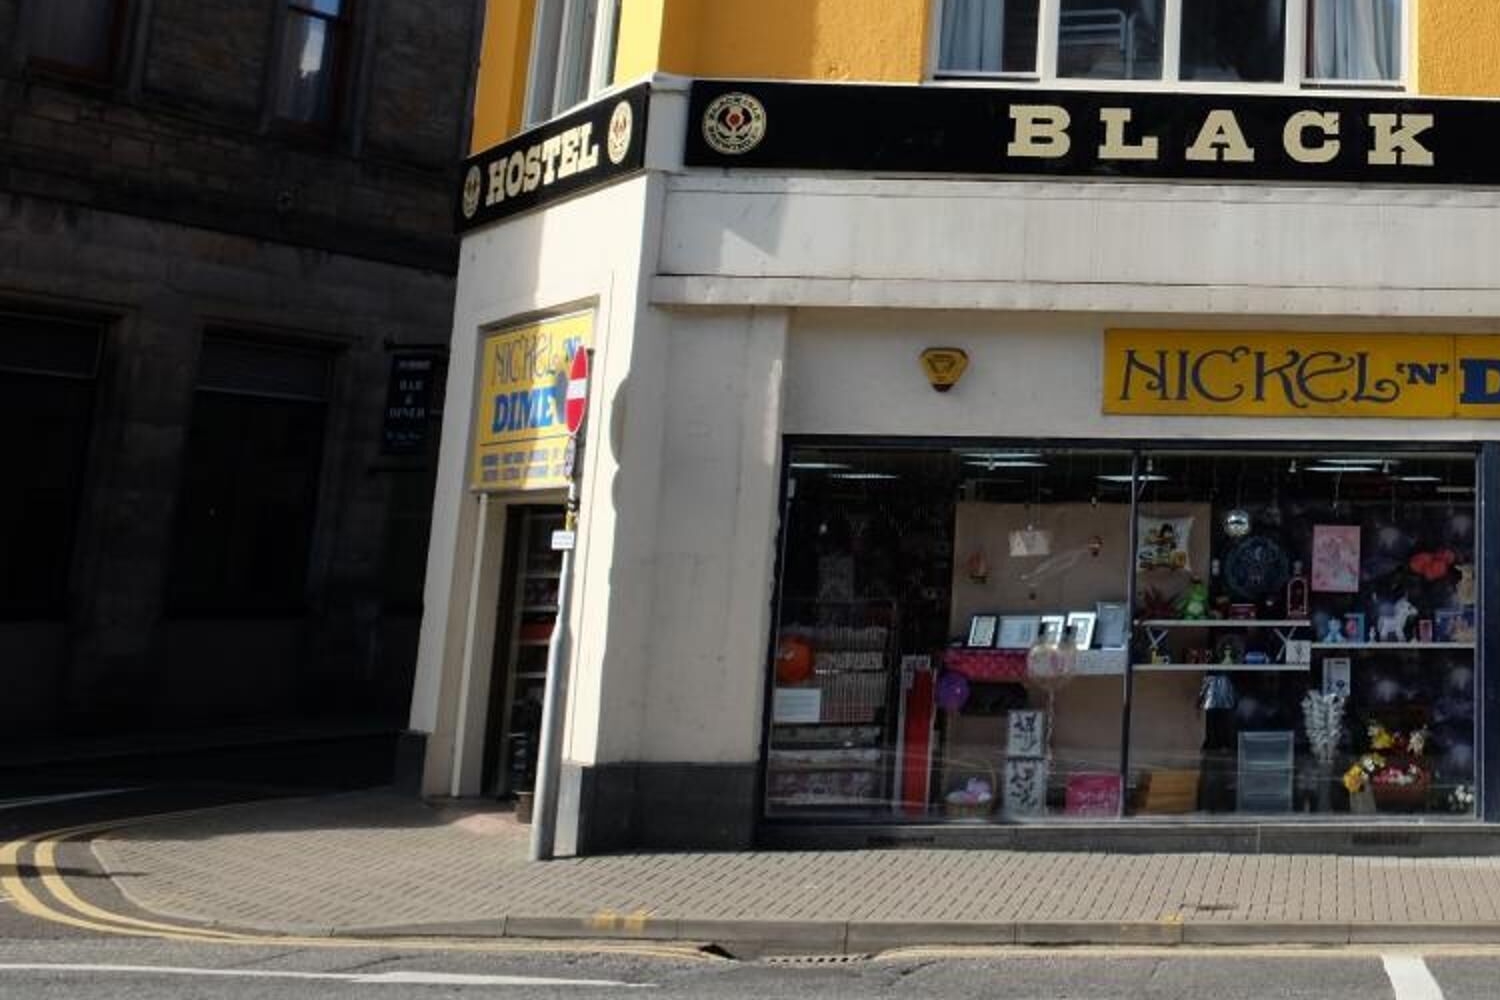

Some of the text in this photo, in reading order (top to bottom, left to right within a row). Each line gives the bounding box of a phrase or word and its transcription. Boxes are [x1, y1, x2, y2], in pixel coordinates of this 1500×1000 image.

[485, 122, 599, 207] HOSTEL
[1007, 104, 1435, 166] BLACK
[490, 332, 558, 388] NICKEL
[1121, 345, 1400, 407] NICKEL
[492, 385, 556, 433] DIME
